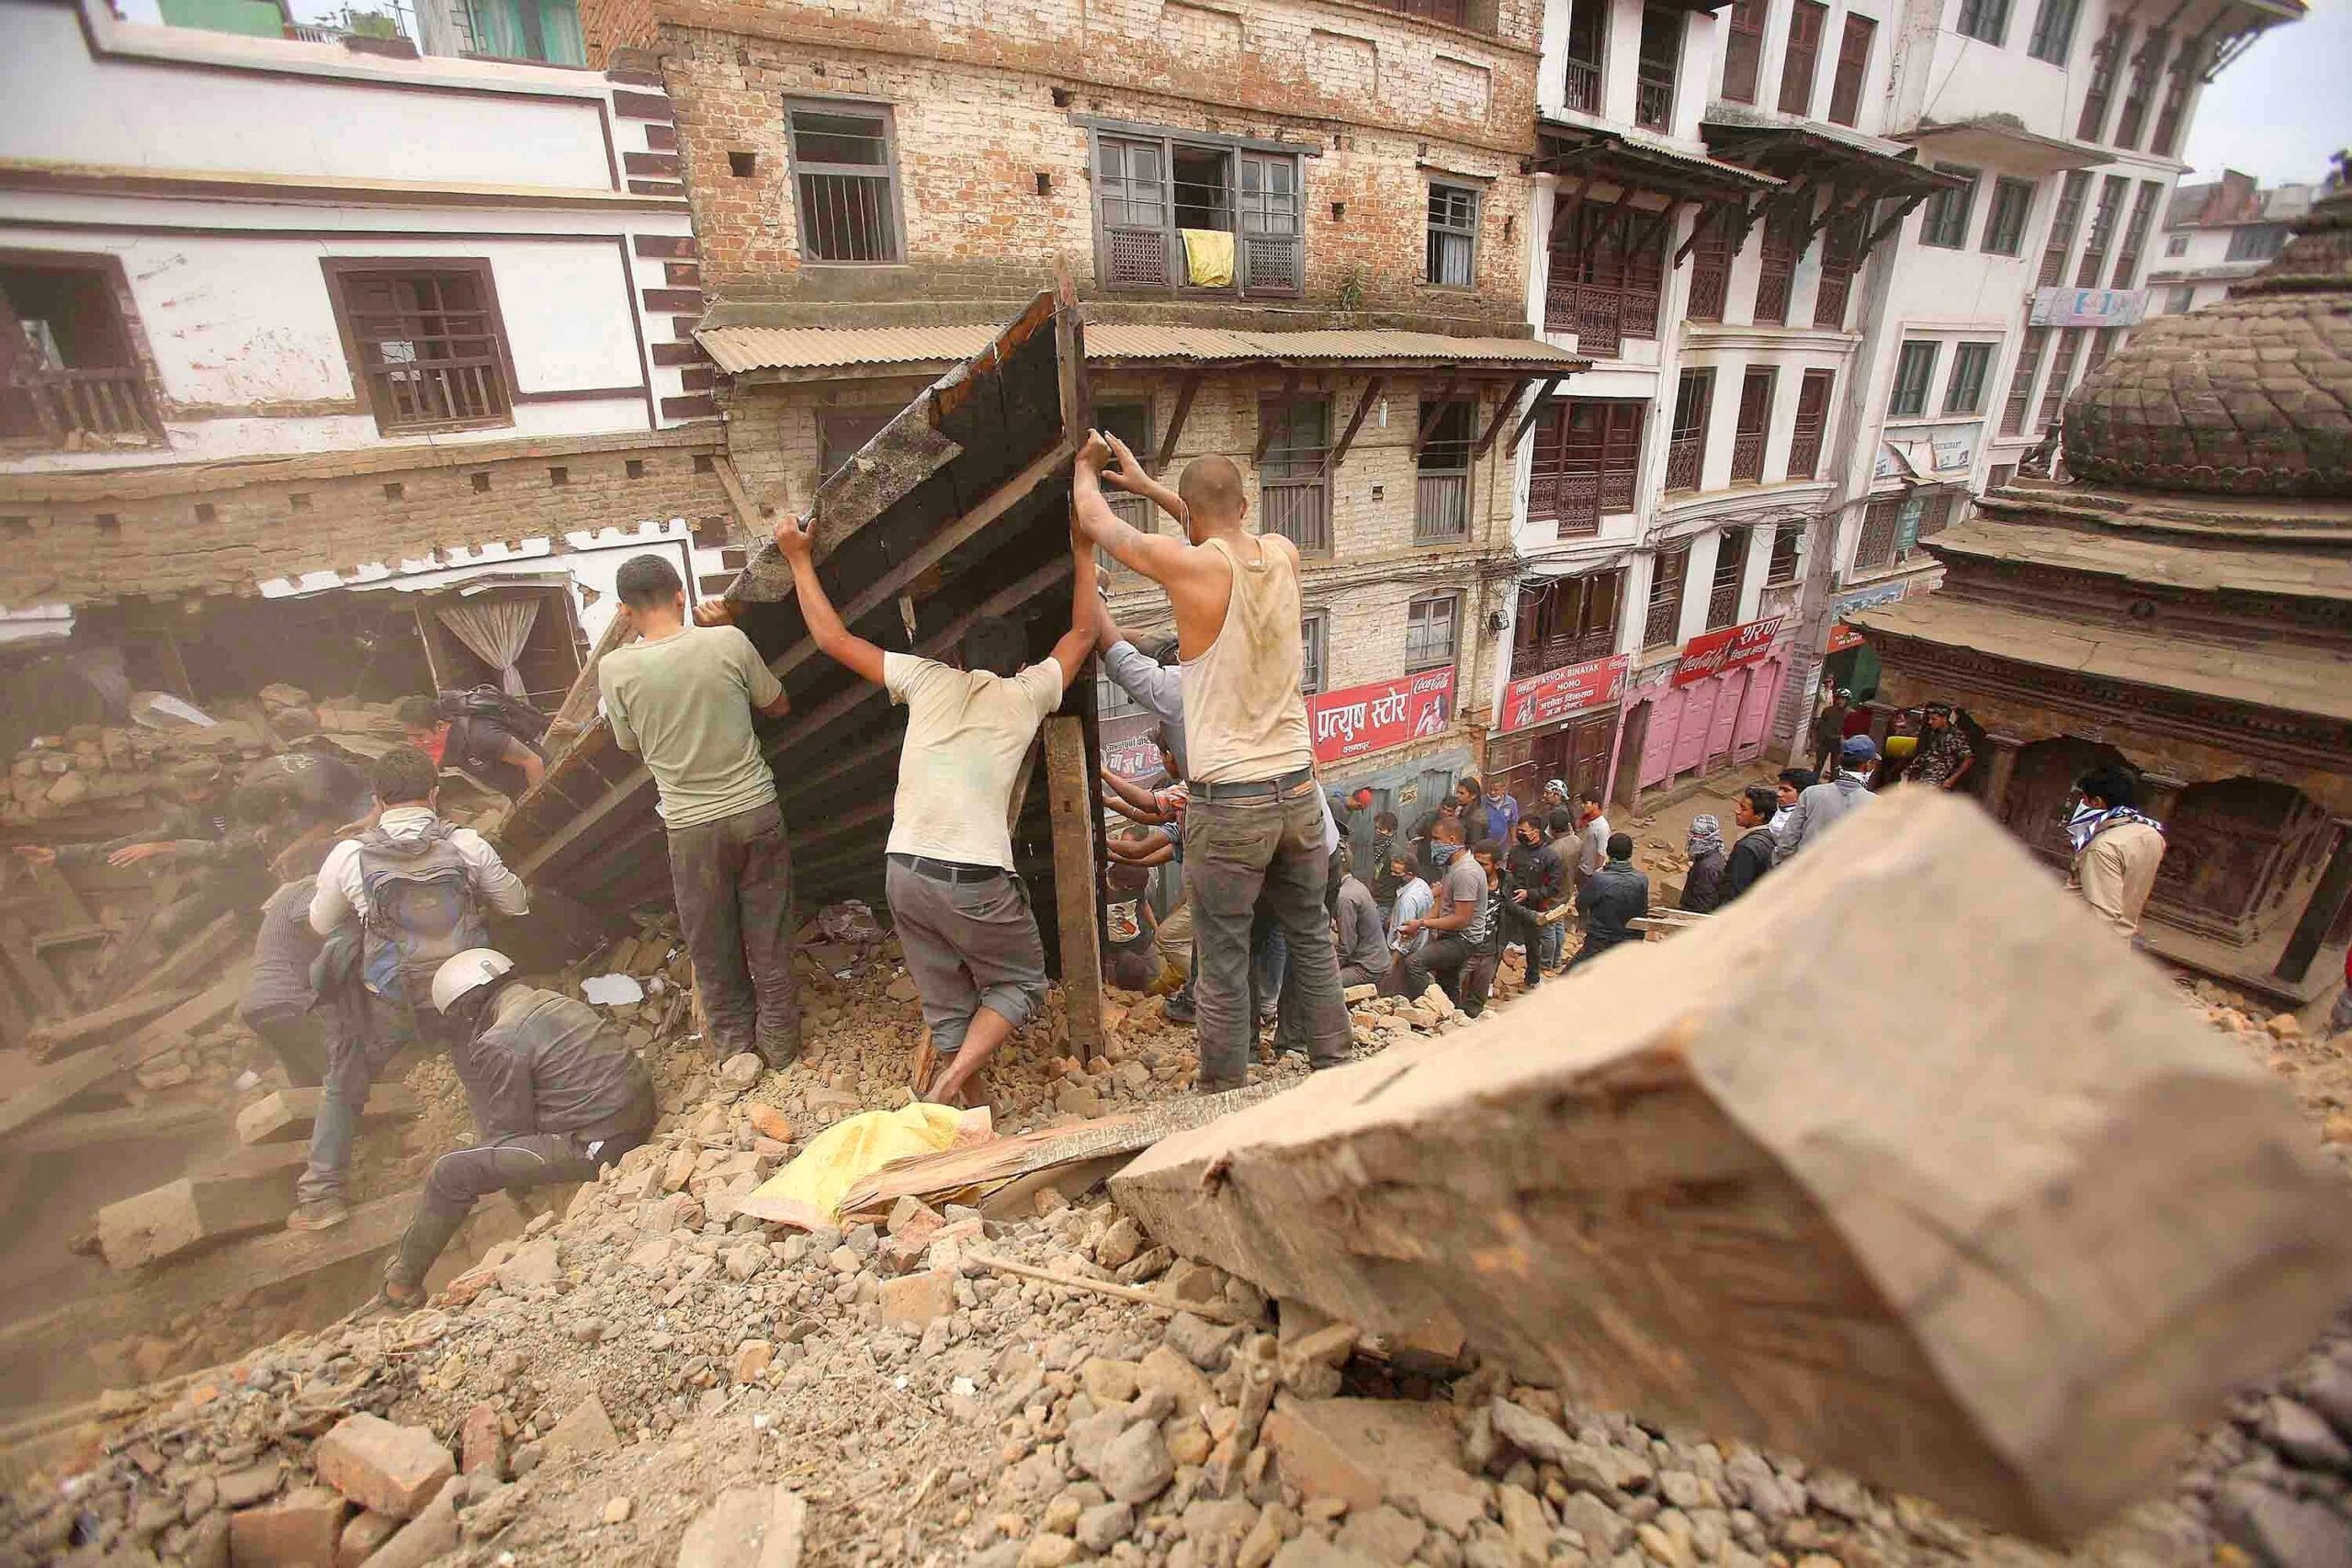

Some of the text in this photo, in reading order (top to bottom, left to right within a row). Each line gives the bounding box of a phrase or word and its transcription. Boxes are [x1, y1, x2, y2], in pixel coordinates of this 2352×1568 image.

[1414, 671, 1451, 694] Coca-Cola
[1541, 663, 1600, 685] ASHOK BINAYAK
[1557, 679, 1580, 691] MOMO
[1317, 687, 1409, 742] प्रत्युष स्टोर
